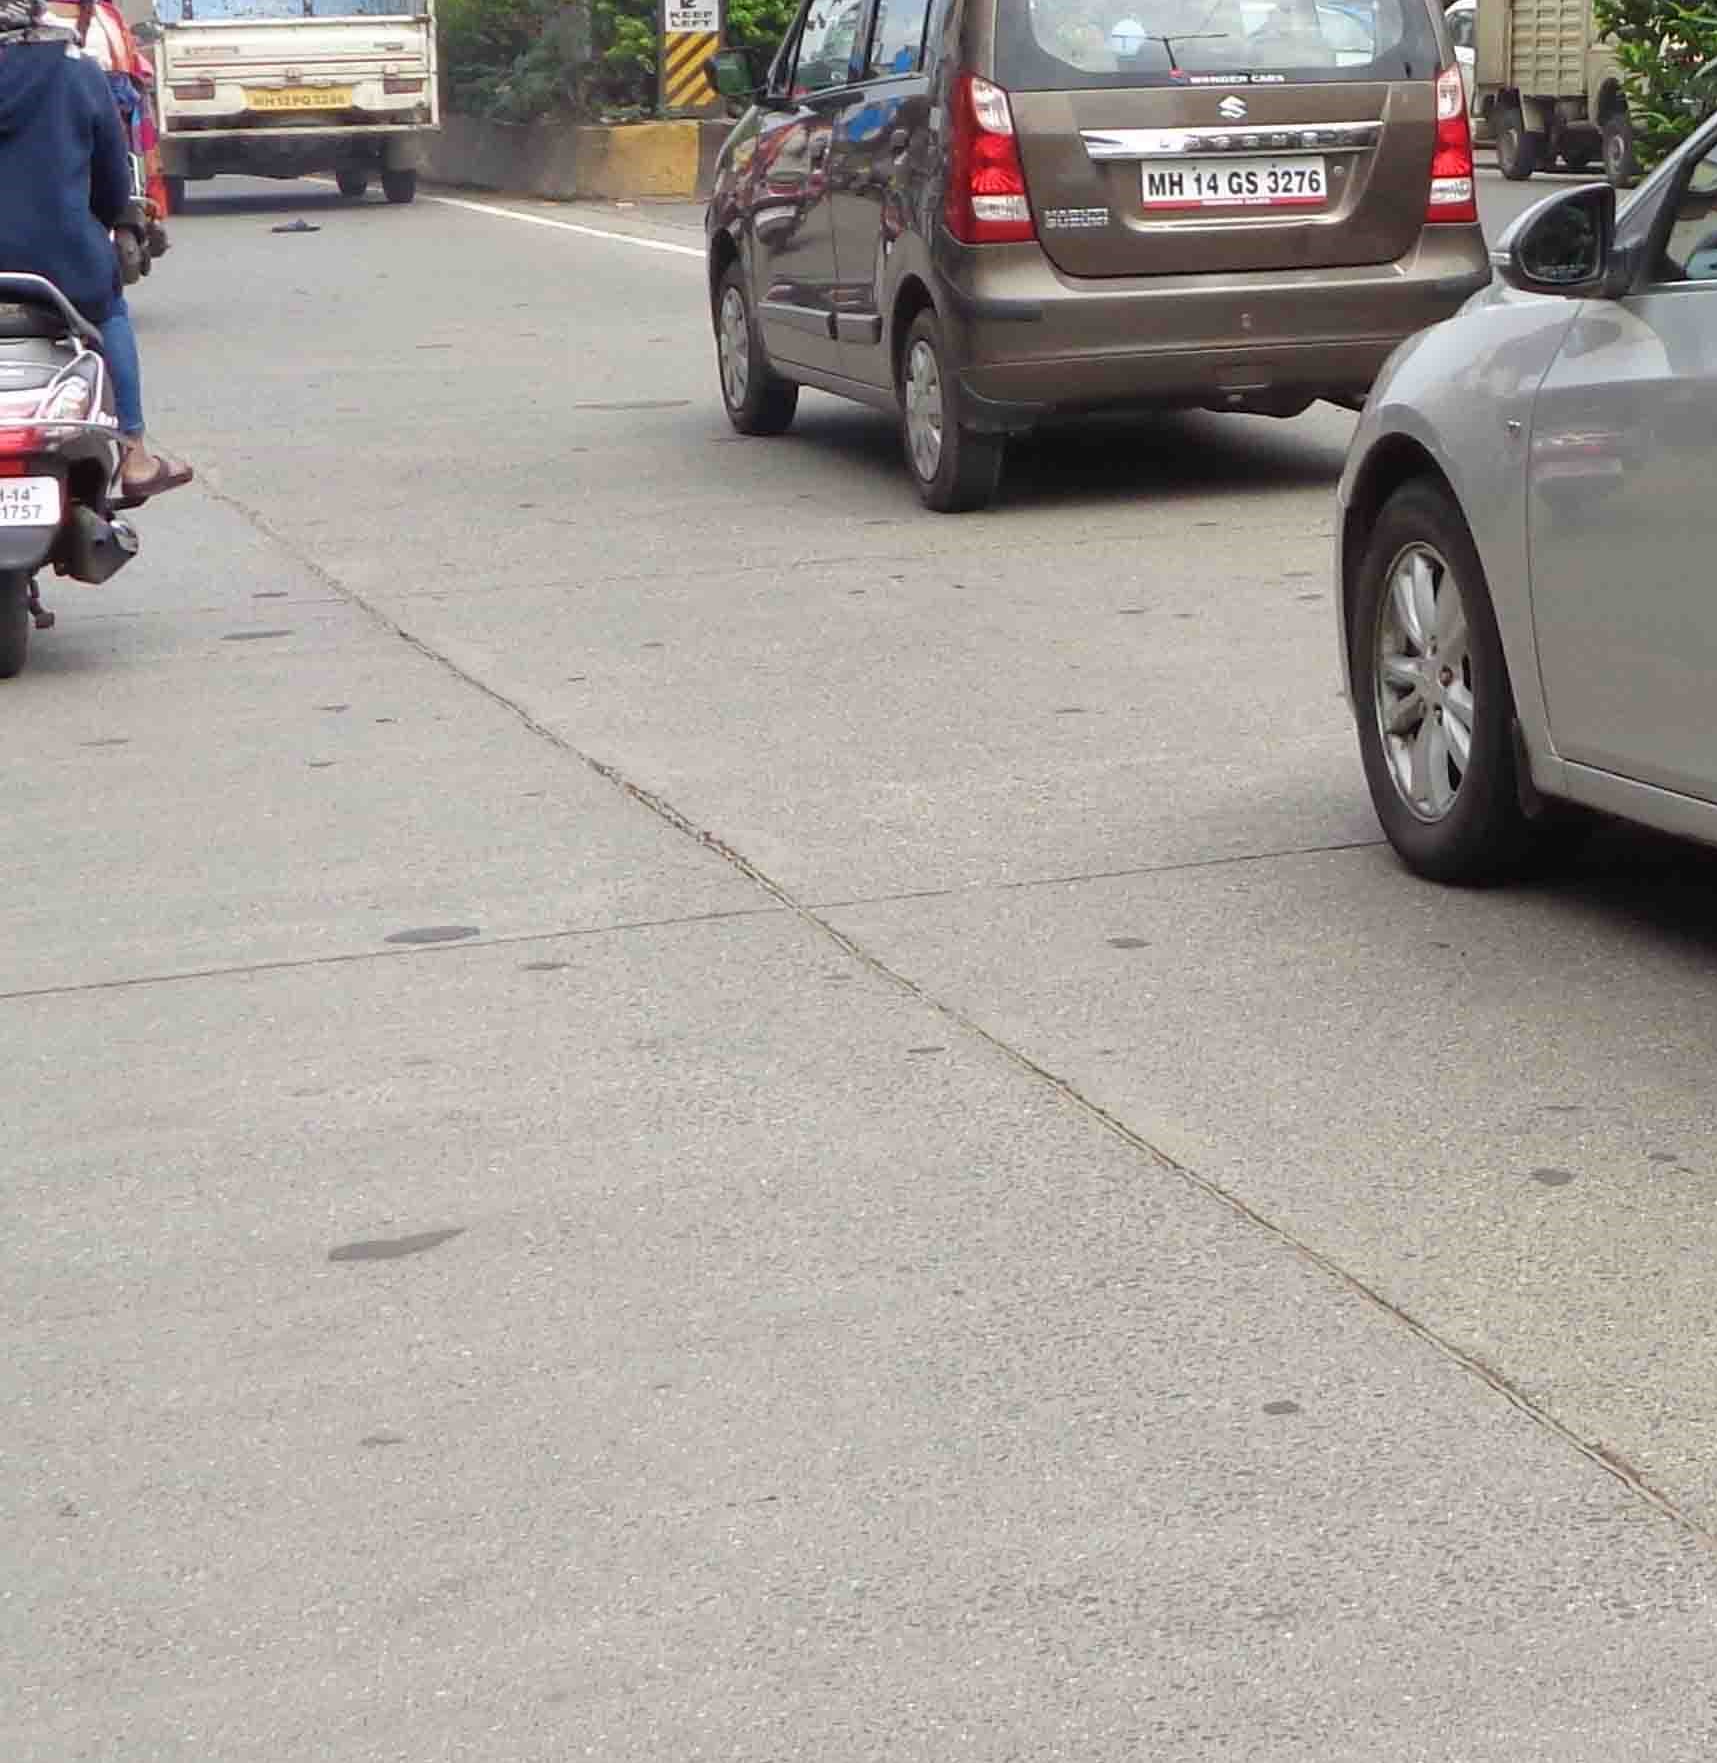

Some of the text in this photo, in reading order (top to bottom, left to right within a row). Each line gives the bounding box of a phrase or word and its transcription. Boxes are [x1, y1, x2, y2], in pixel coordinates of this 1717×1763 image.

[670, 10, 713, 18] KEEP
[671, 19, 713, 28] LEFT
[1147, 169, 1323, 196] MH 14 GS 3276
